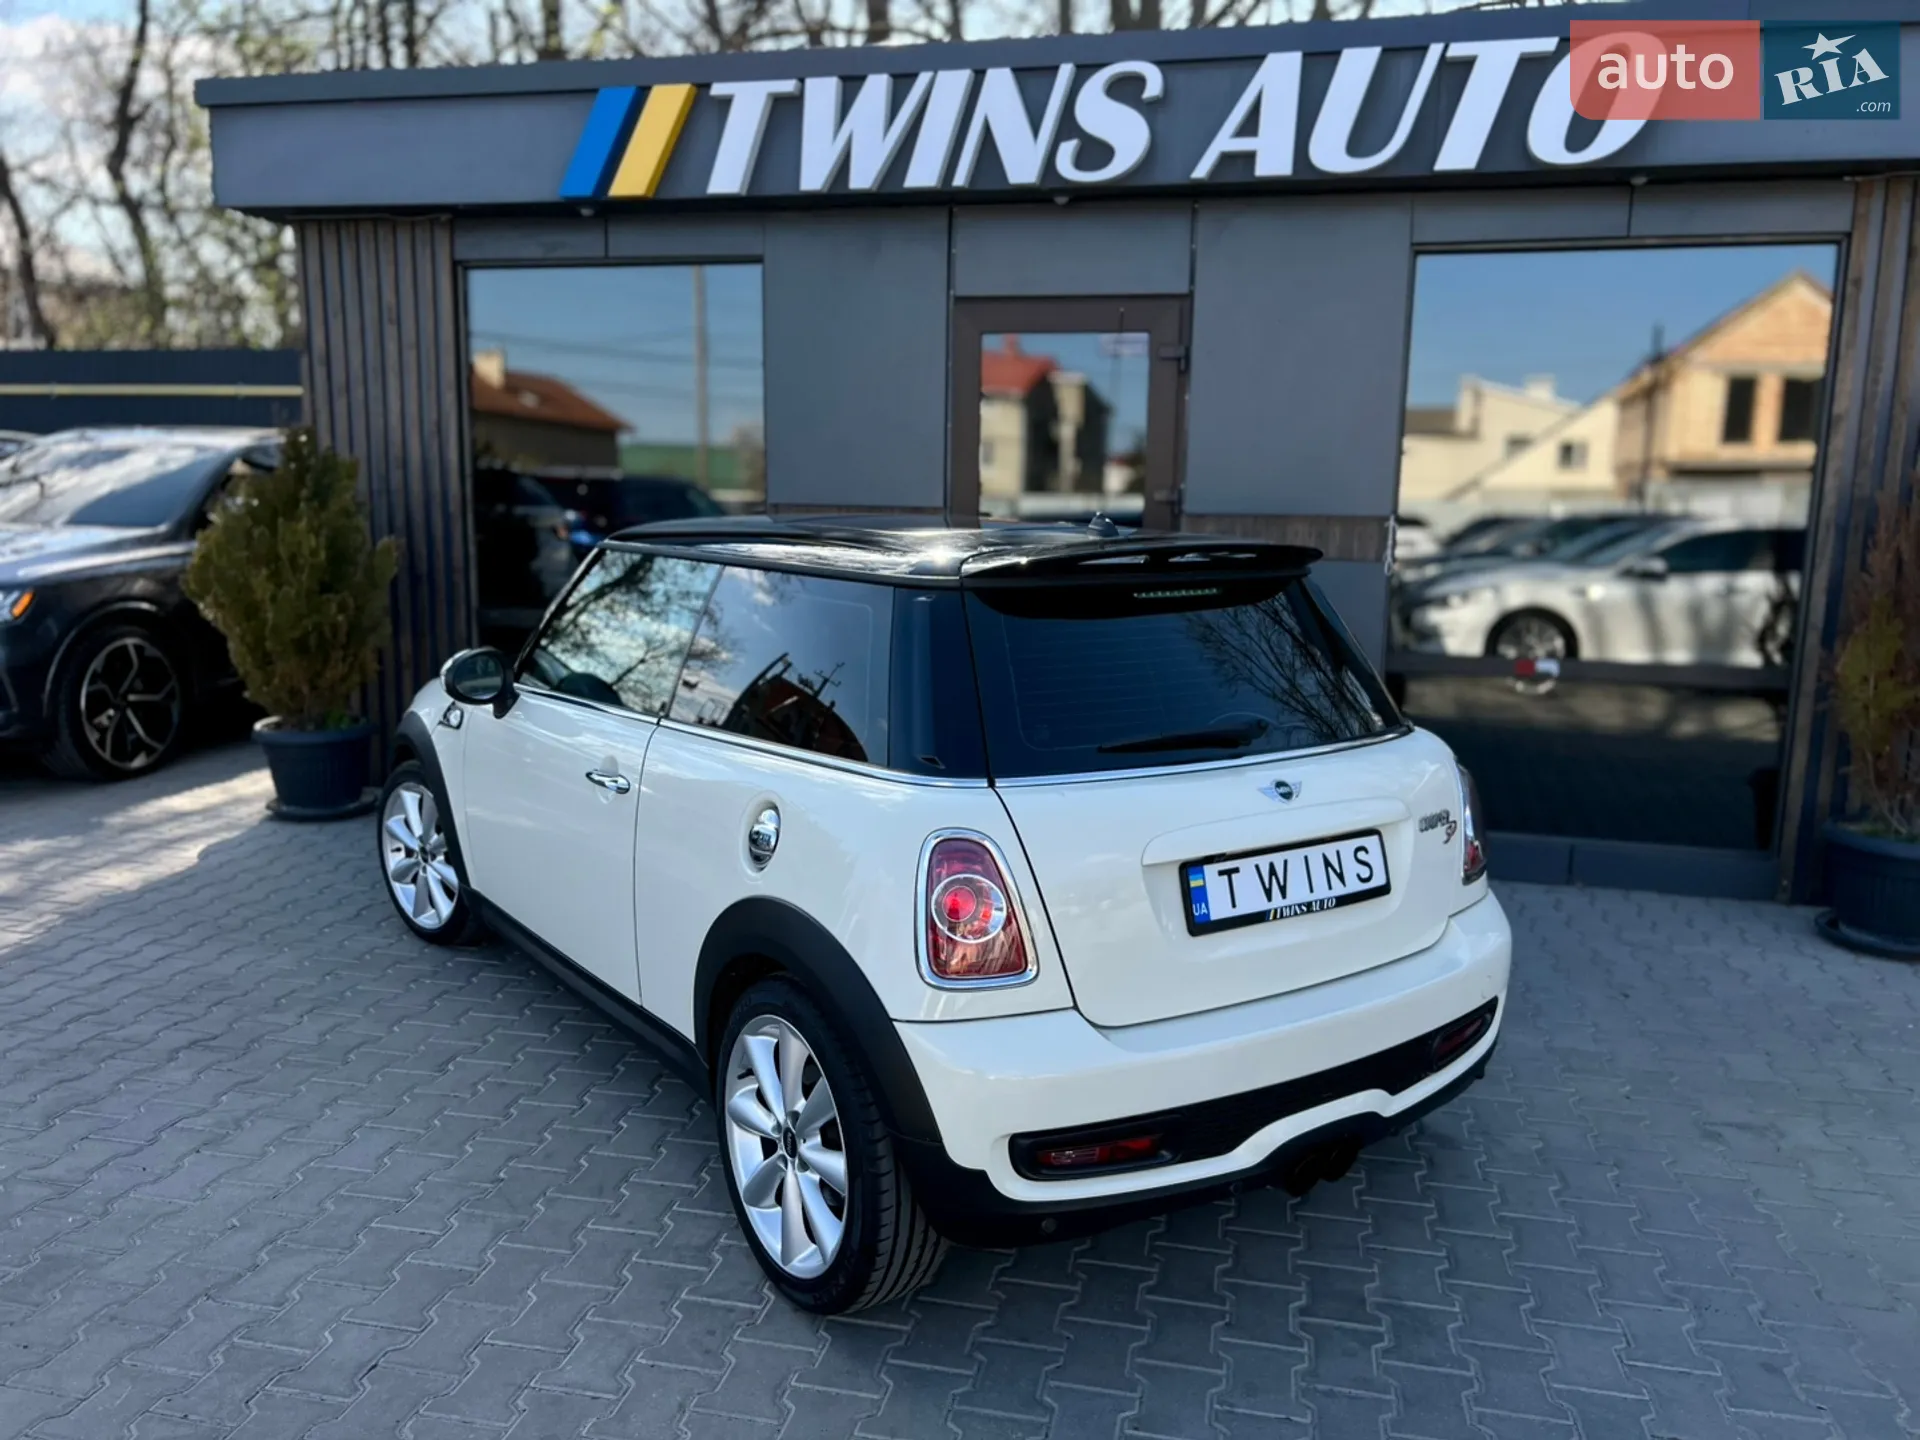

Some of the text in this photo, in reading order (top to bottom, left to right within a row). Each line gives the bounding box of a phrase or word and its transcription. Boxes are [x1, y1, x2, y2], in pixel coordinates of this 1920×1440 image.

[706, 31, 1667, 195] TWINS AUTO
[1217, 845, 1374, 909] TWINS
[1192, 902, 1209, 916] UA
[1276, 897, 1336, 919] TWINS AUTO
